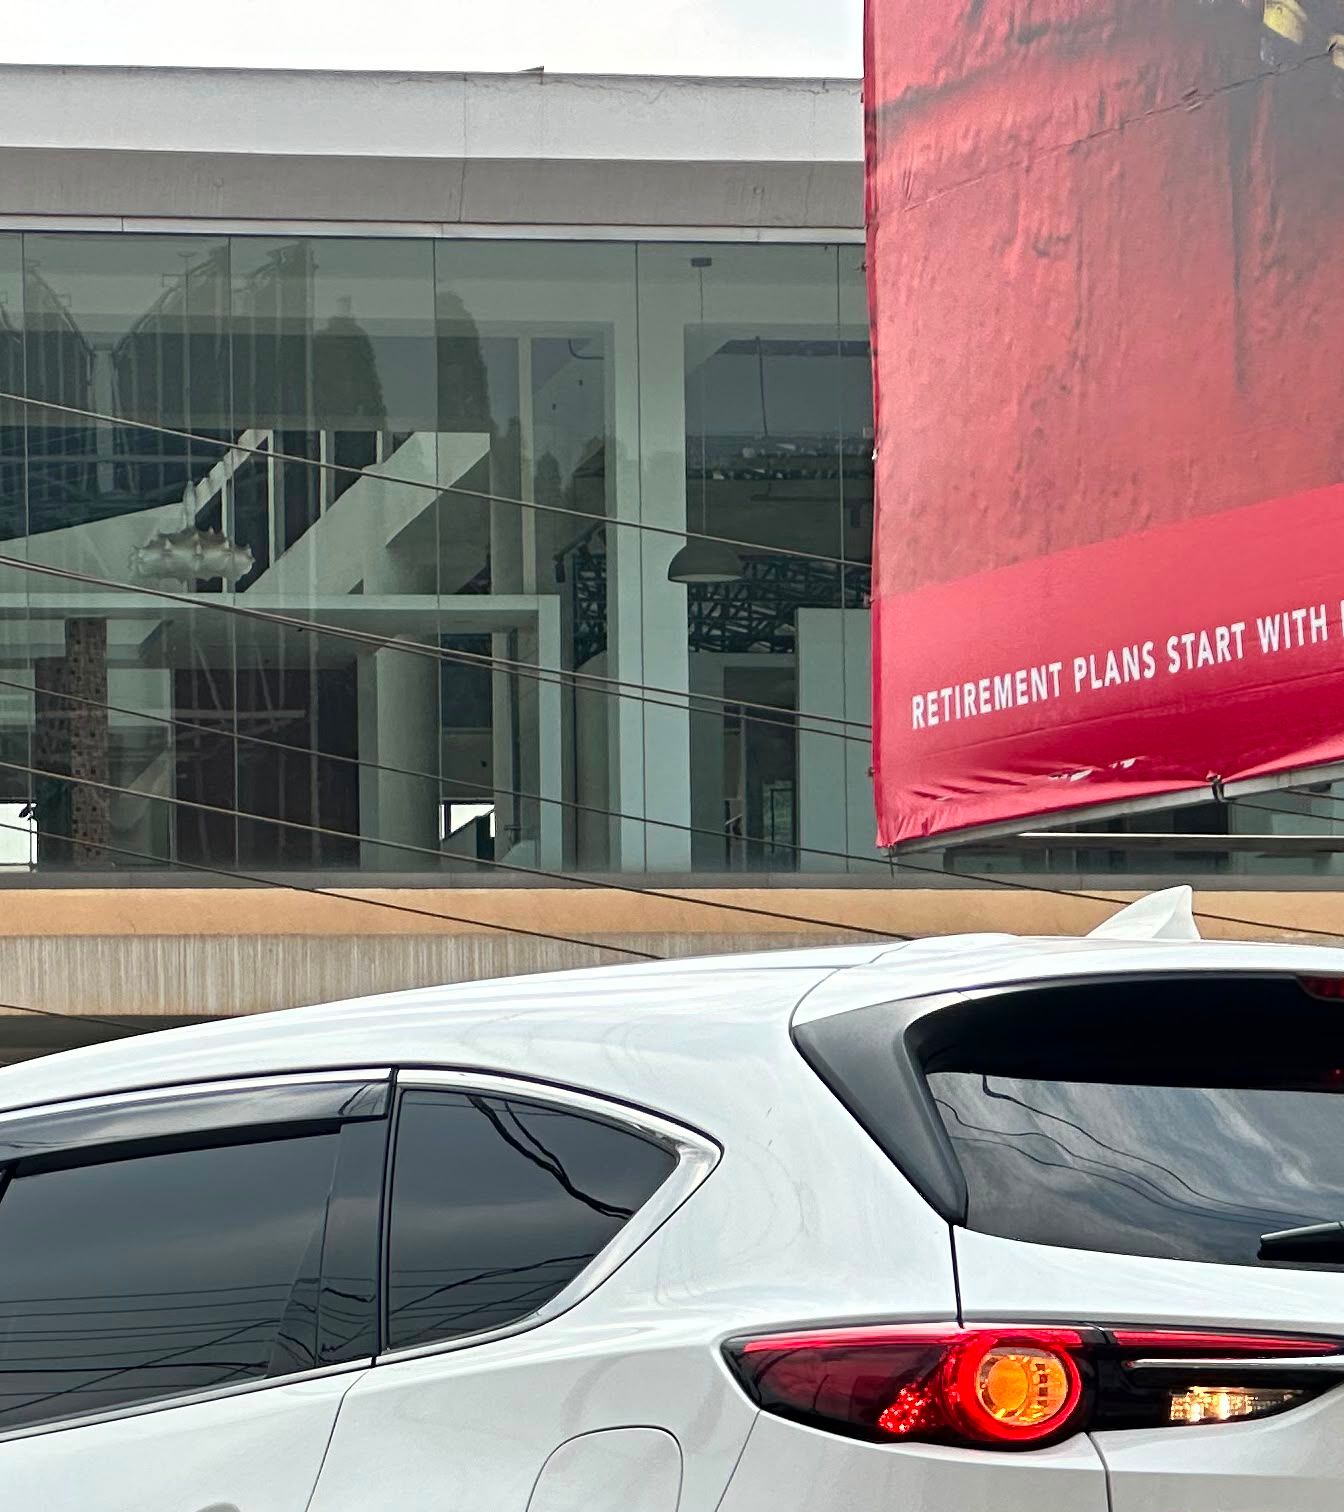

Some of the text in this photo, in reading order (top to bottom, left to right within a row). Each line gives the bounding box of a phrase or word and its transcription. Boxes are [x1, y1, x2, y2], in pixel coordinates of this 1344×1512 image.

[911, 661, 1063, 729] RETIREMENT
[1073, 641, 1156, 693] PLANS
[1166, 621, 1246, 674] START
[1256, 604, 1328, 654] WITH
